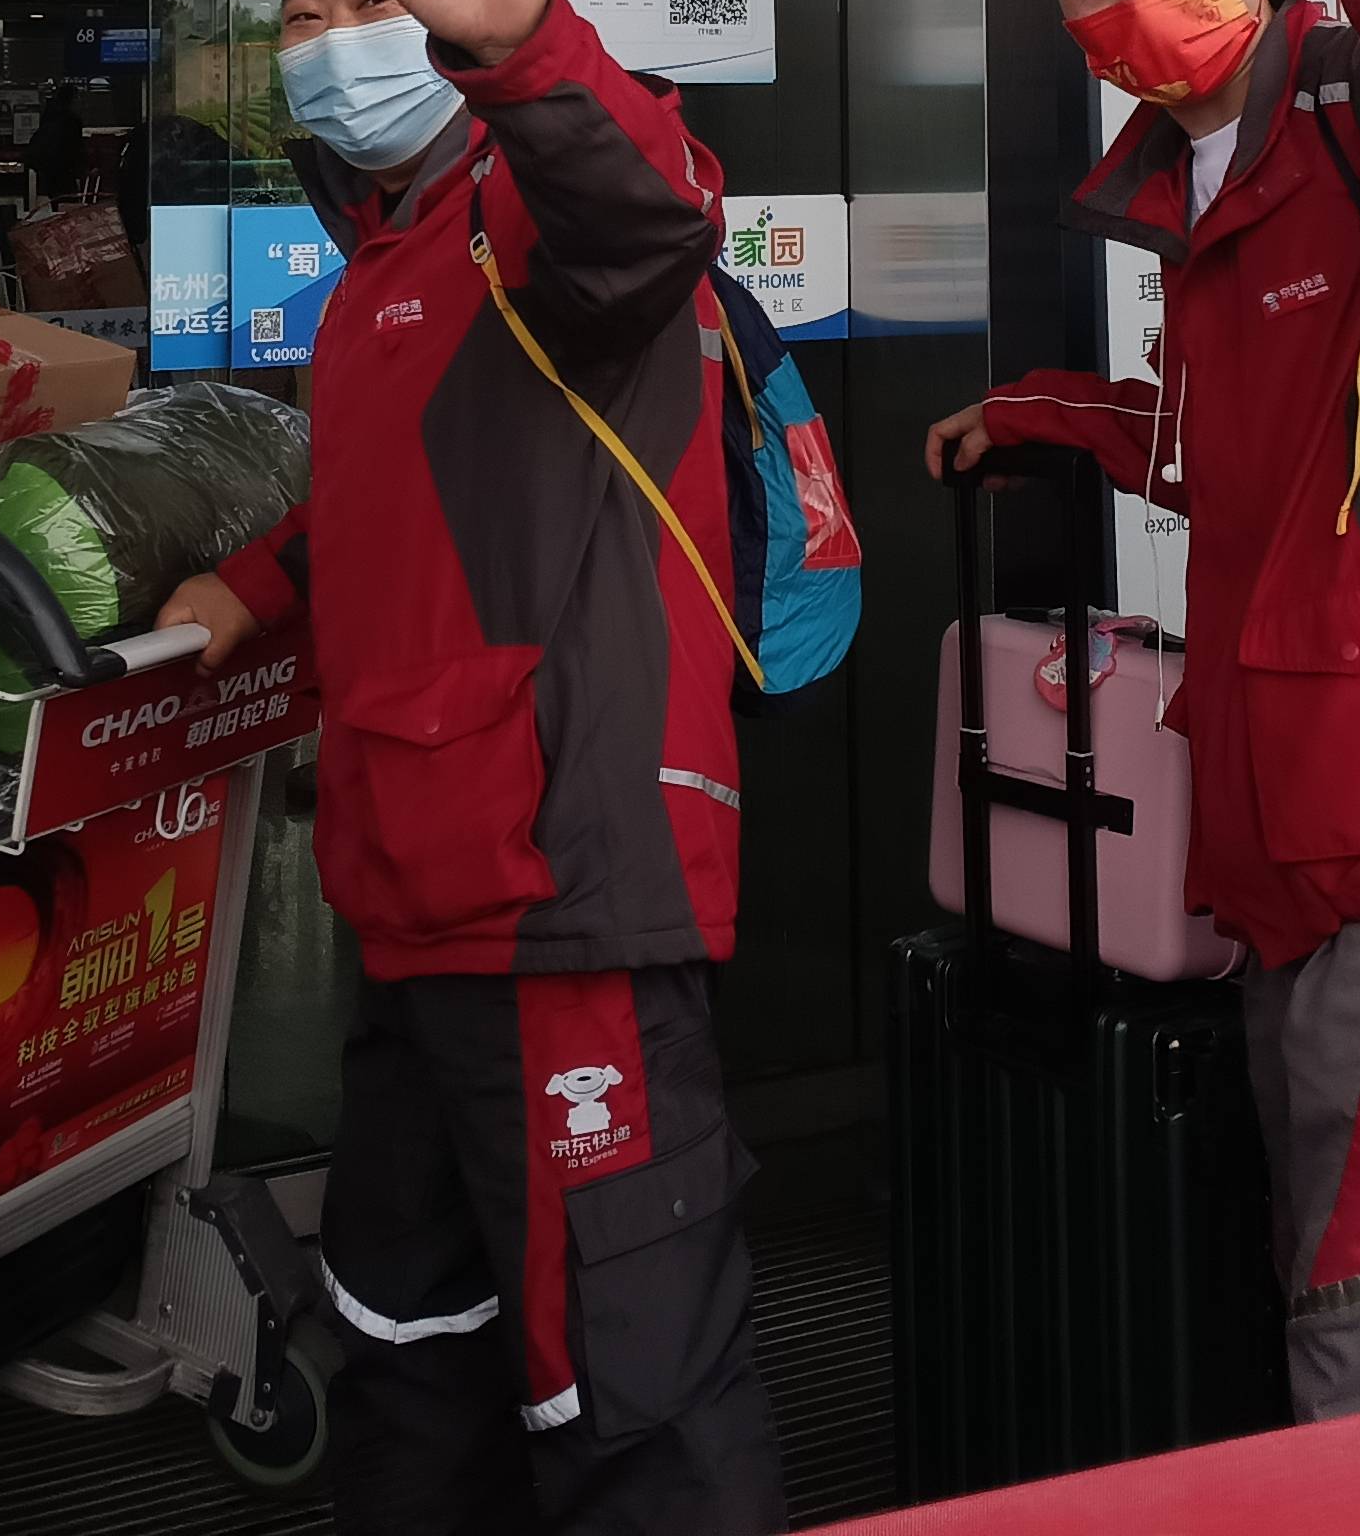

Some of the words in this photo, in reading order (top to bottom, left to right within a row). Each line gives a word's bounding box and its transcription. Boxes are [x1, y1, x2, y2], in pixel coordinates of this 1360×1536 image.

[76, 28, 95, 44] 68
[759, 272, 805, 289] HOME
[153, 307, 228, 336] 亚运会
[81, 694, 181, 748] CHAO
[216, 655, 297, 704] YANG
[185, 692, 291, 751] 朝阳轮胎
[550, 1124, 631, 1158] 京东快递
